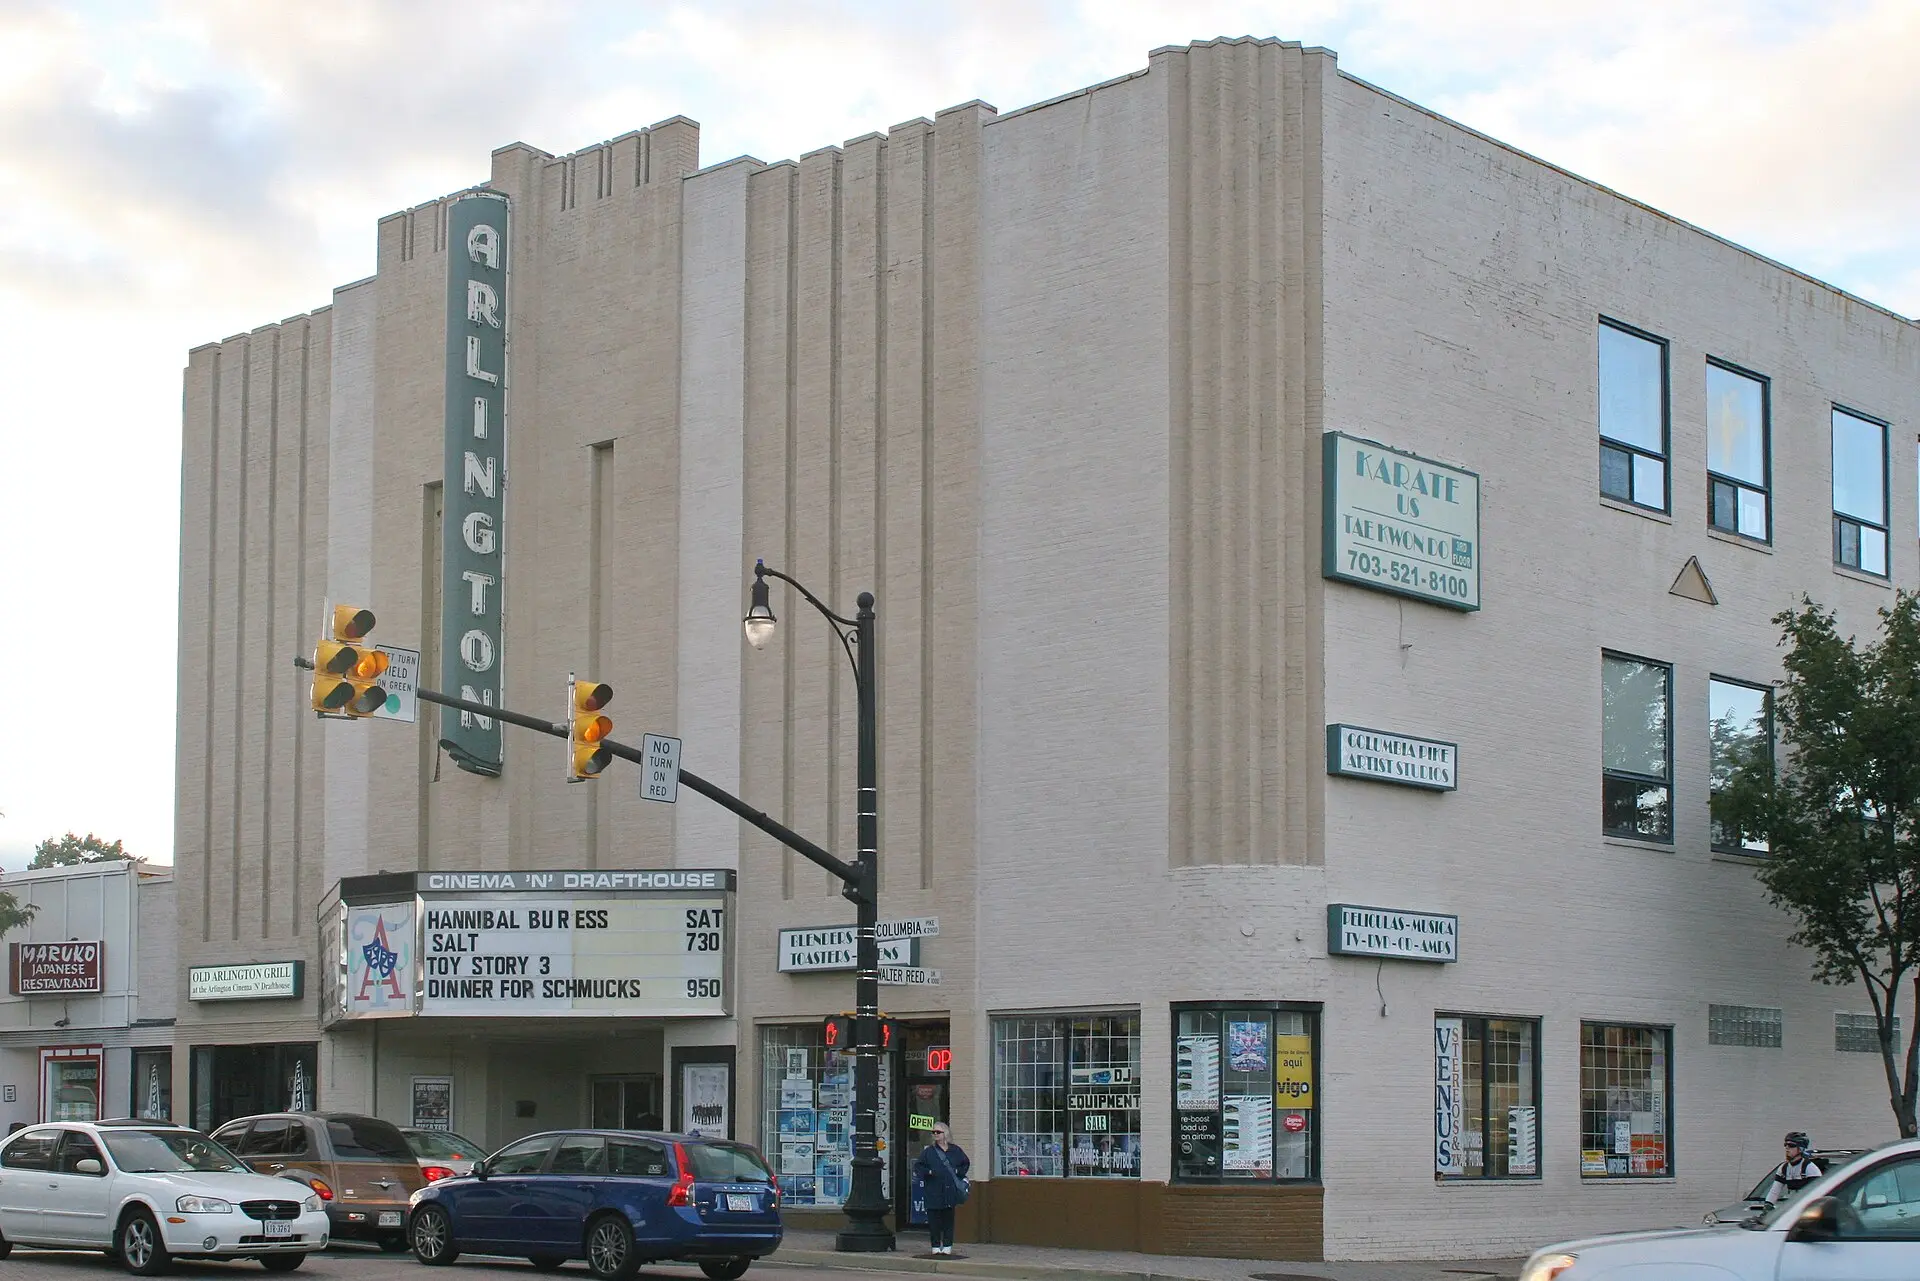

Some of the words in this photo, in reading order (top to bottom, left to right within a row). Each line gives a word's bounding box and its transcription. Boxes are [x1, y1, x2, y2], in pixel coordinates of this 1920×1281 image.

[461, 224, 501, 731] ARLINGTON
[1356, 450, 1460, 504] KARATE
[1397, 494, 1420, 518] US
[1343, 514, 1374, 540] TAE
[1377, 523, 1424, 553] KWON
[1428, 537, 1449, 559] DO
[1453, 554, 1472, 568] FLOOR
[1348, 549, 1468, 598] 703-521-8100
[398, 655, 416, 665] TURN
[377, 679, 386, 689] ON
[653, 741, 670, 754] NO
[1348, 733, 1415, 758] COLUMBIA
[1419, 745, 1449, 763] PIKE
[650, 756, 672, 769] TURN
[1347, 754, 1393, 774] ARTIST
[1396, 761, 1449, 783] STUDIOS
[653, 771, 665, 782] ON
[650, 785, 667, 796] RED
[429, 874, 516, 889] CINEMA
[525, 874, 553, 888] 'N'
[564, 873, 715, 888] DRAFTHOUSE
[428, 910, 520, 929] HANNIBAL
[686, 909, 723, 929] SAT
[876, 921, 922, 938] COLUMBIA
[925, 919, 935, 927] PIKE
[432, 933, 478, 952] SALT
[686, 932, 719, 951] 730
[22, 944, 96, 963] MARUKO
[32, 963, 85, 977] JAPANESE
[426, 956, 461, 975] TOY
[472, 956, 529, 975] STORY
[539, 956, 550, 975] 3
[193, 971, 210, 982] OLD
[213, 969, 262, 981] ARLINGTON
[264, 967, 291, 979] GRILL
[906, 969, 925, 983] REED
[22, 977, 96, 990] RESTAURANT
[199, 985, 208, 993] the
[208, 984, 231, 994] Arlington
[232, 983, 252, 991] Cinema
[261, 982, 290, 990] Drafthouse
[428, 979, 493, 998] DINNER
[500, 979, 534, 999] FOR
[542, 979, 640, 998] SCHMUCKS
[687, 979, 720, 998] 950
[1284, 1057, 1302, 1069] aquí
[1114, 1069, 1131, 1082] DJ
[1452, 1028, 1460, 1136] STEREOS
[1277, 1078, 1309, 1097] vigo
[1068, 1094, 1140, 1109] EQUIPMENT
[1436, 1028, 1451, 1167] VENUS
[911, 1116, 932, 1128] OPEN
[1087, 1116, 1105, 1130] SALE
[1181, 1115, 1210, 1123] re-boost
